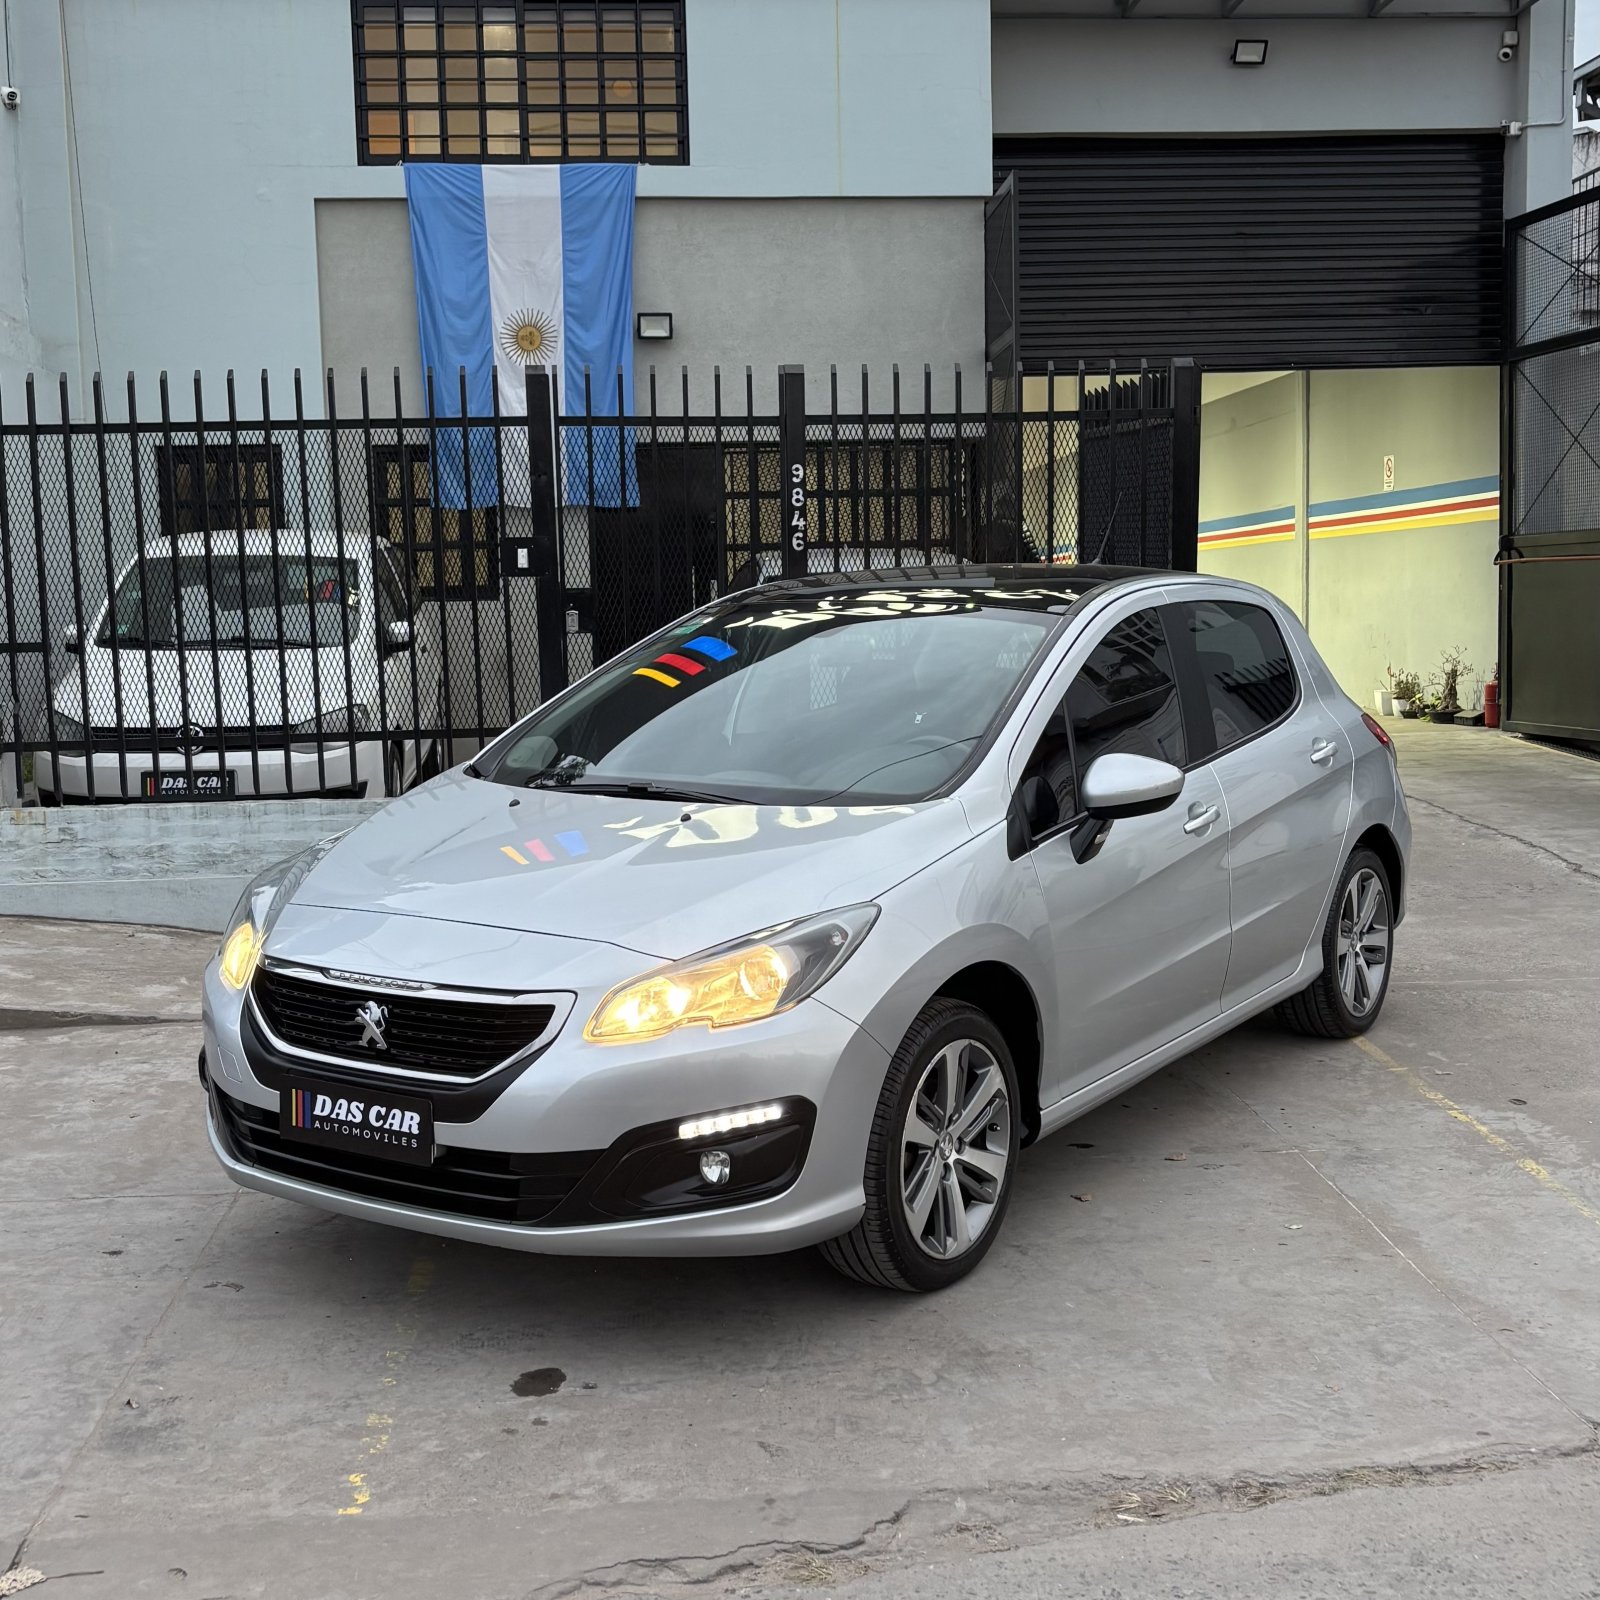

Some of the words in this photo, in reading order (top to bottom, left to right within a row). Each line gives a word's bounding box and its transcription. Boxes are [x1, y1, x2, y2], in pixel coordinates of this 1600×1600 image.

[791, 463, 806, 551] 9846
[339, 972, 410, 990] PEUGEOT
[313, 1094, 365, 1123] DAS
[368, 1105, 421, 1135] CAR
[313, 1120, 418, 1148] AUTOMOVILES
